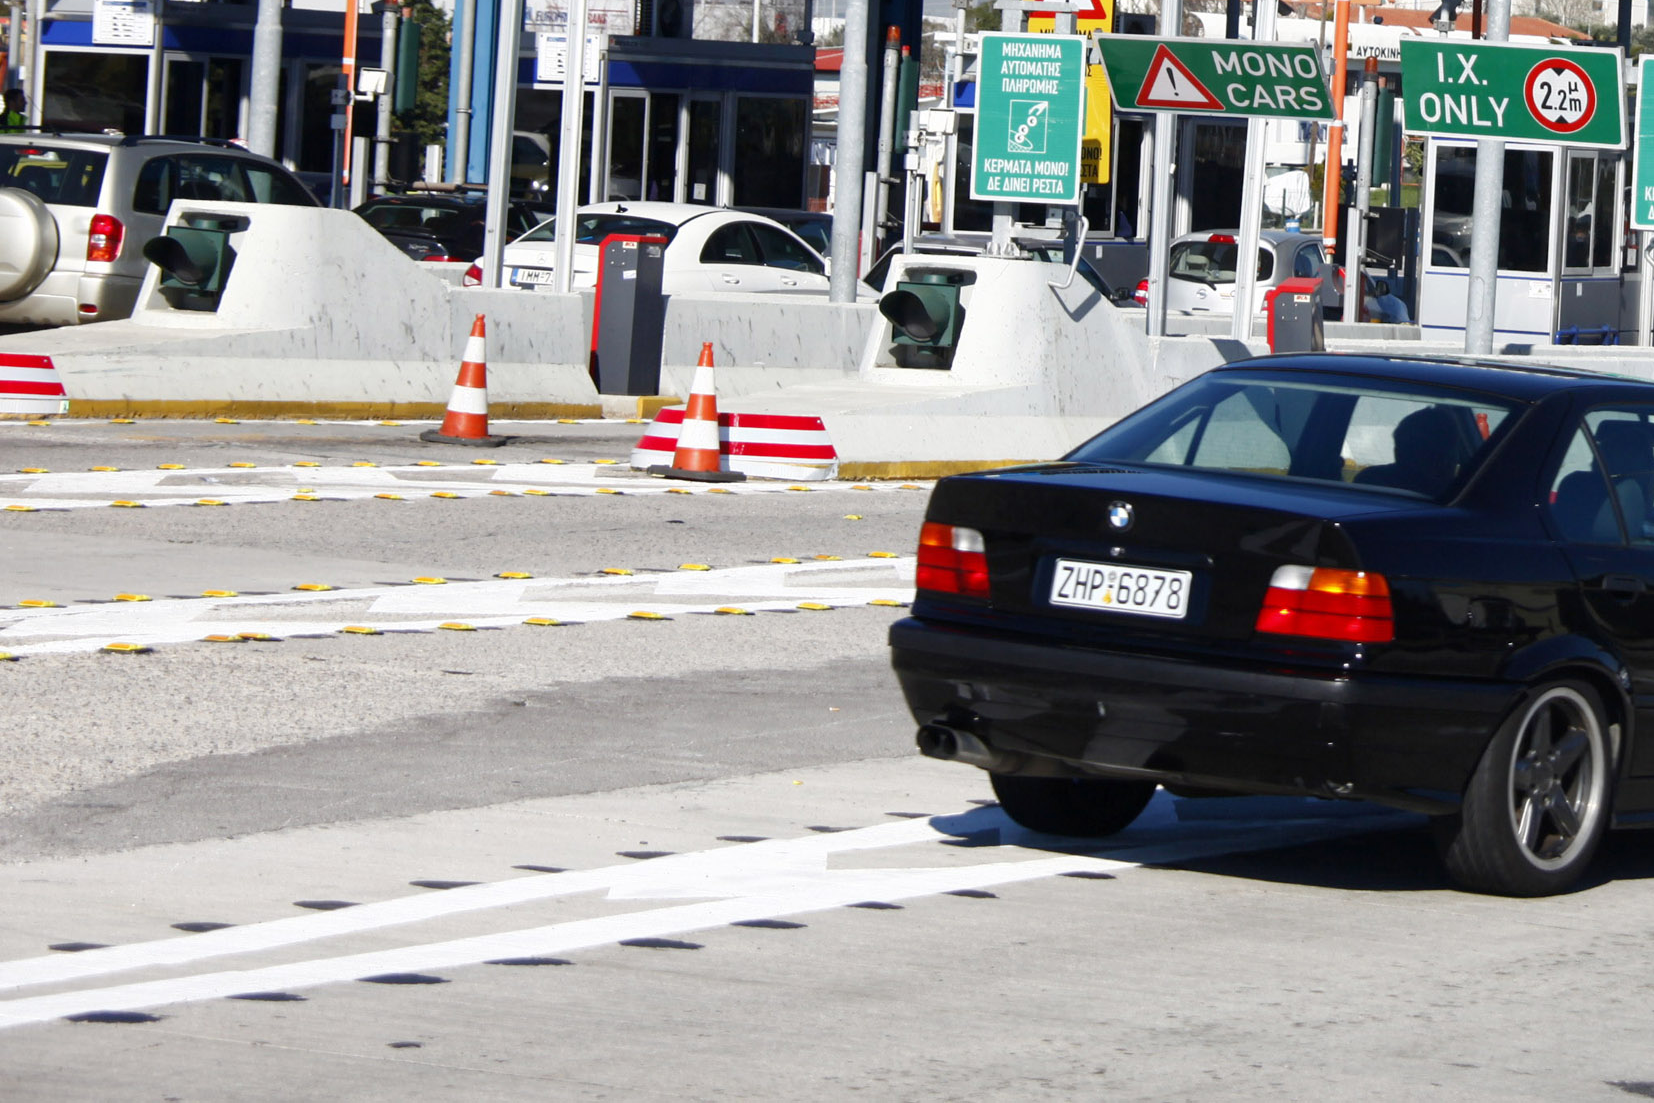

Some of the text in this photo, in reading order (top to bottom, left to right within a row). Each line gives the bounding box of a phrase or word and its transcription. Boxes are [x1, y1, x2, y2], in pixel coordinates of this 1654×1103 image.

[1002, 42, 1062, 59] ΜΗΧΑΝΗΜΑ
[1356, 45, 1400, 59] ΑΥΤΟΚΙΝΗ
[1001, 60, 1062, 77] ΑΥΤΟΜΑΤΗΣ
[1002, 78, 1059, 94] ΠΛΗΡΩΜΗΣ
[1227, 83, 1323, 111] CARS
[1419, 92, 1509, 127] ONLY
[984, 158, 1032, 175] ΚΕΡΜΑΤΑ
[987, 176, 1064, 194] ΔΕ ΔΙΝΕΙ ΡΕΣΤΑ
